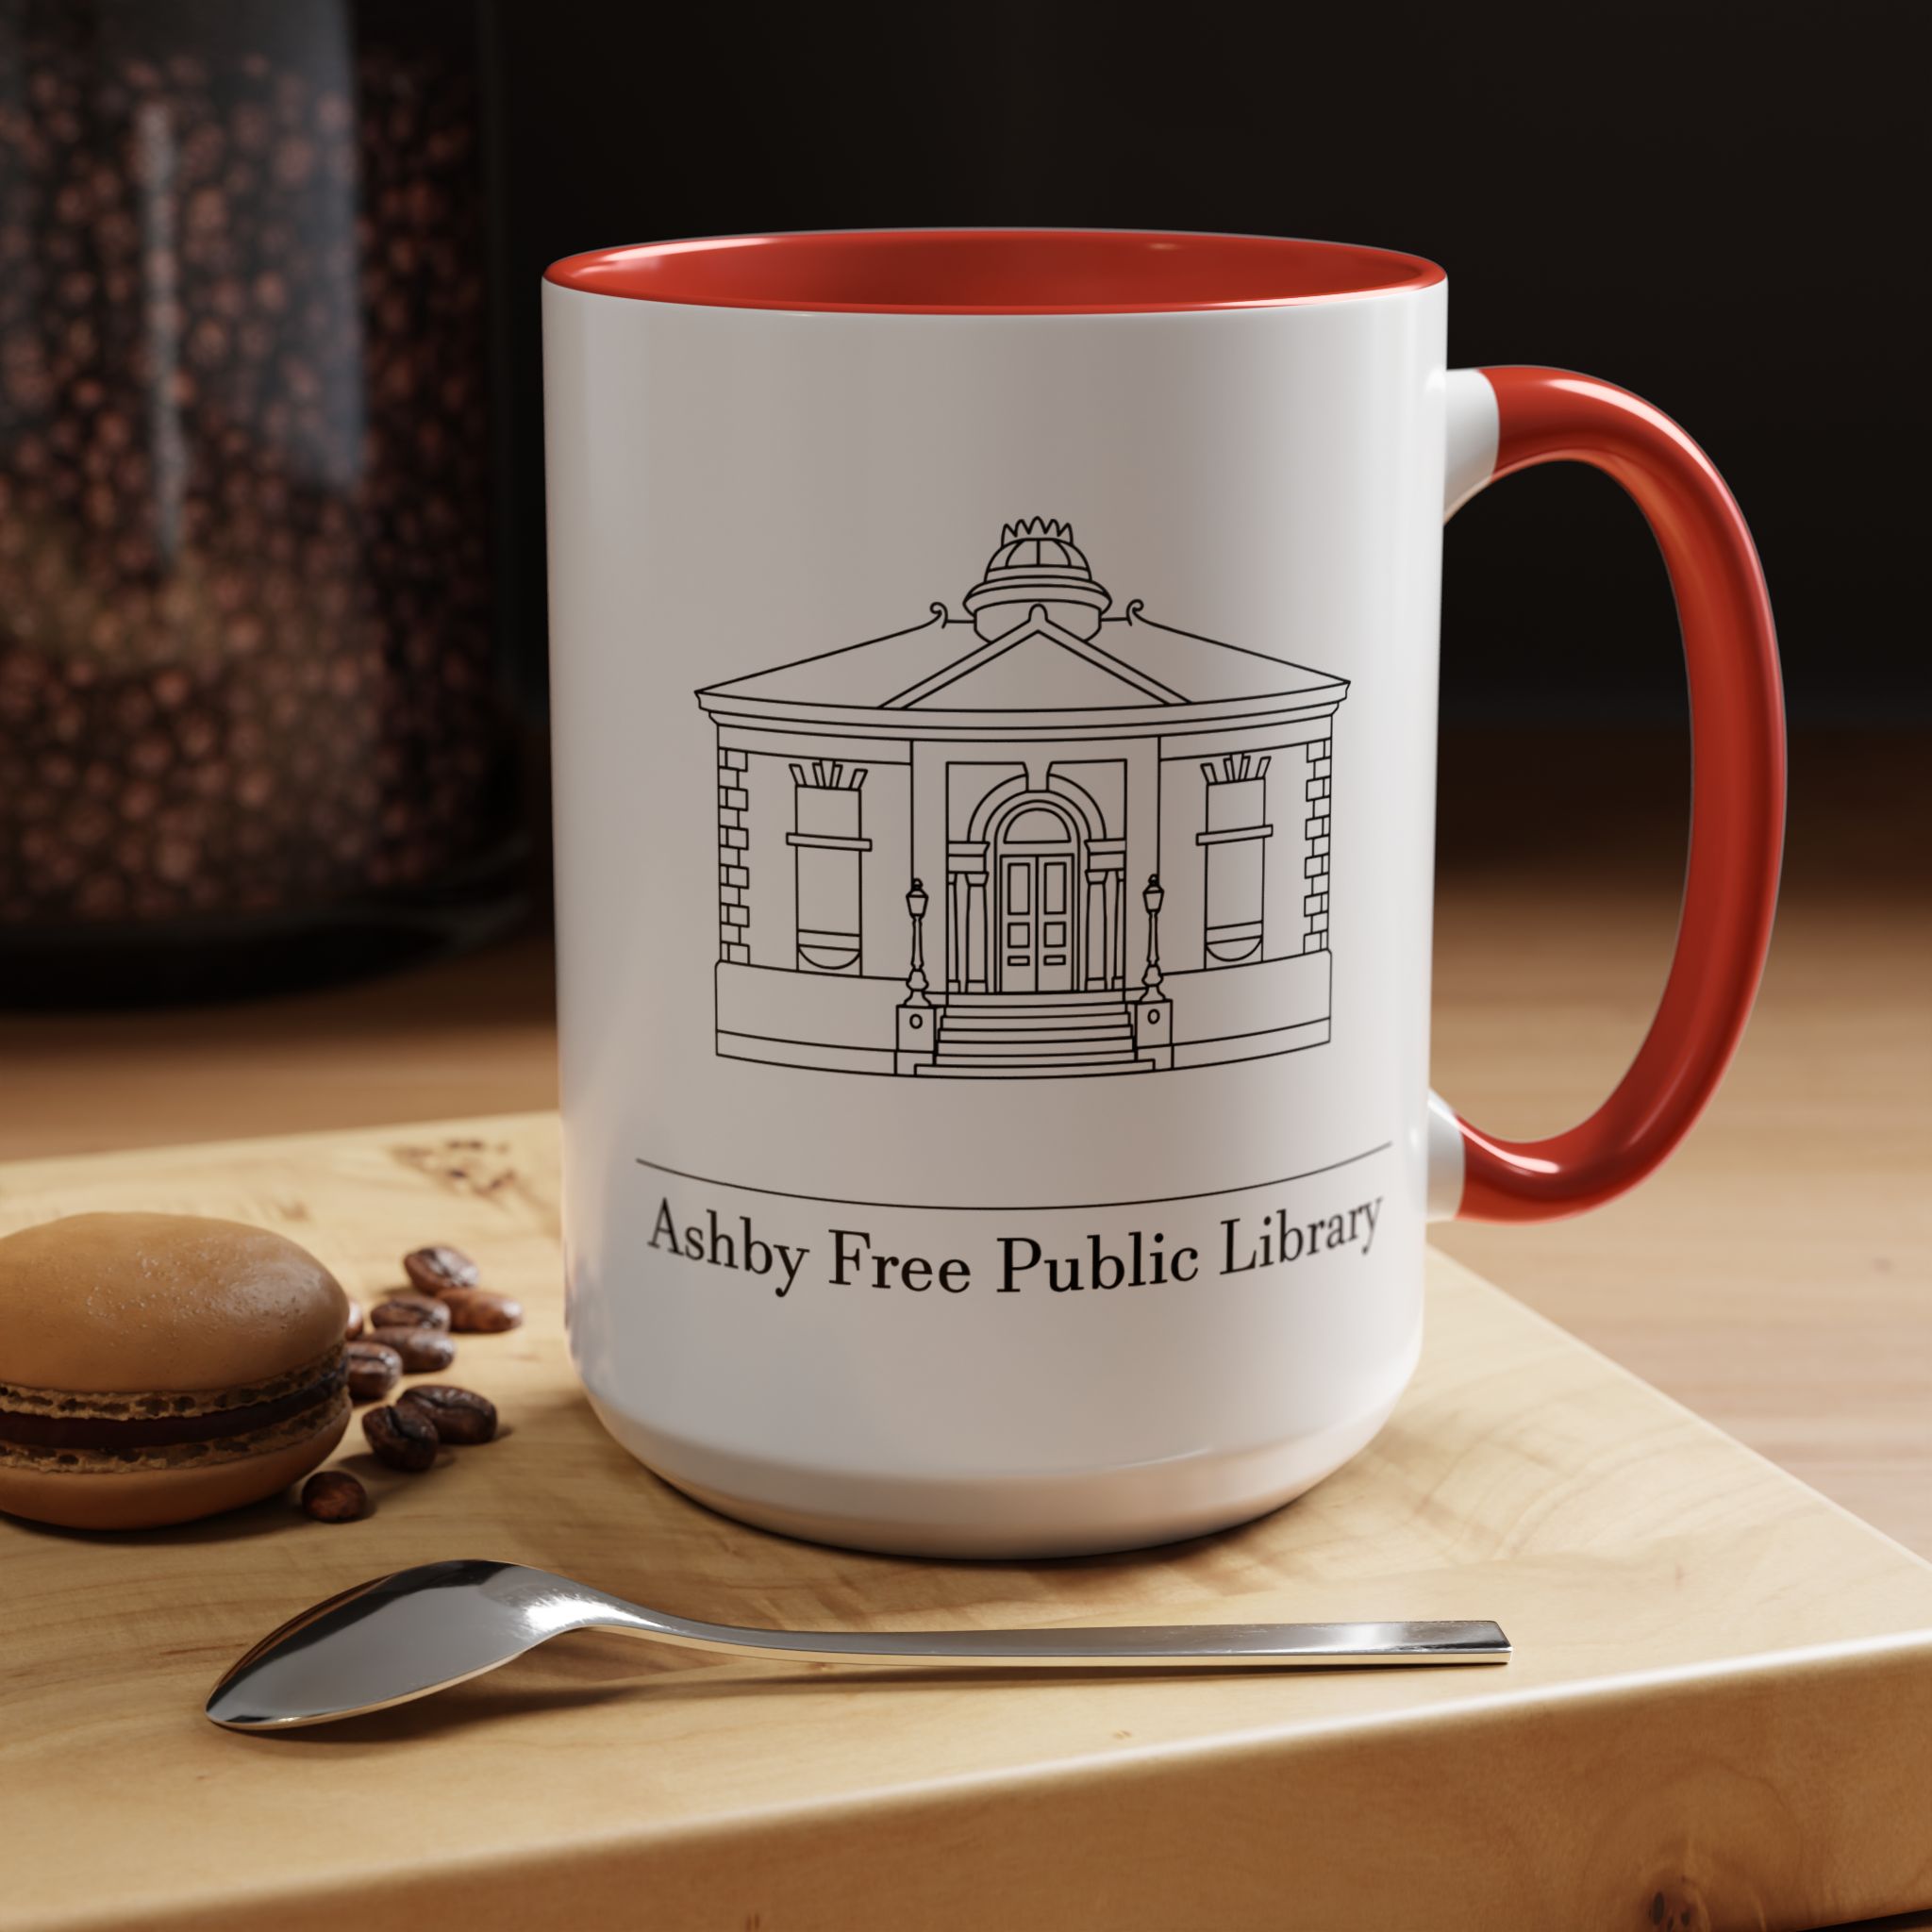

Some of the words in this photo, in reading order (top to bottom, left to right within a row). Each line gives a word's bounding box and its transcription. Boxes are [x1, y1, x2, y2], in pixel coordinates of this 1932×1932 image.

[647, 1196, 810, 1298] Ashby
[827, 1228, 972, 1294] Free
[995, 1230, 1200, 1294] Public
[1218, 1195, 1383, 1276] Library
